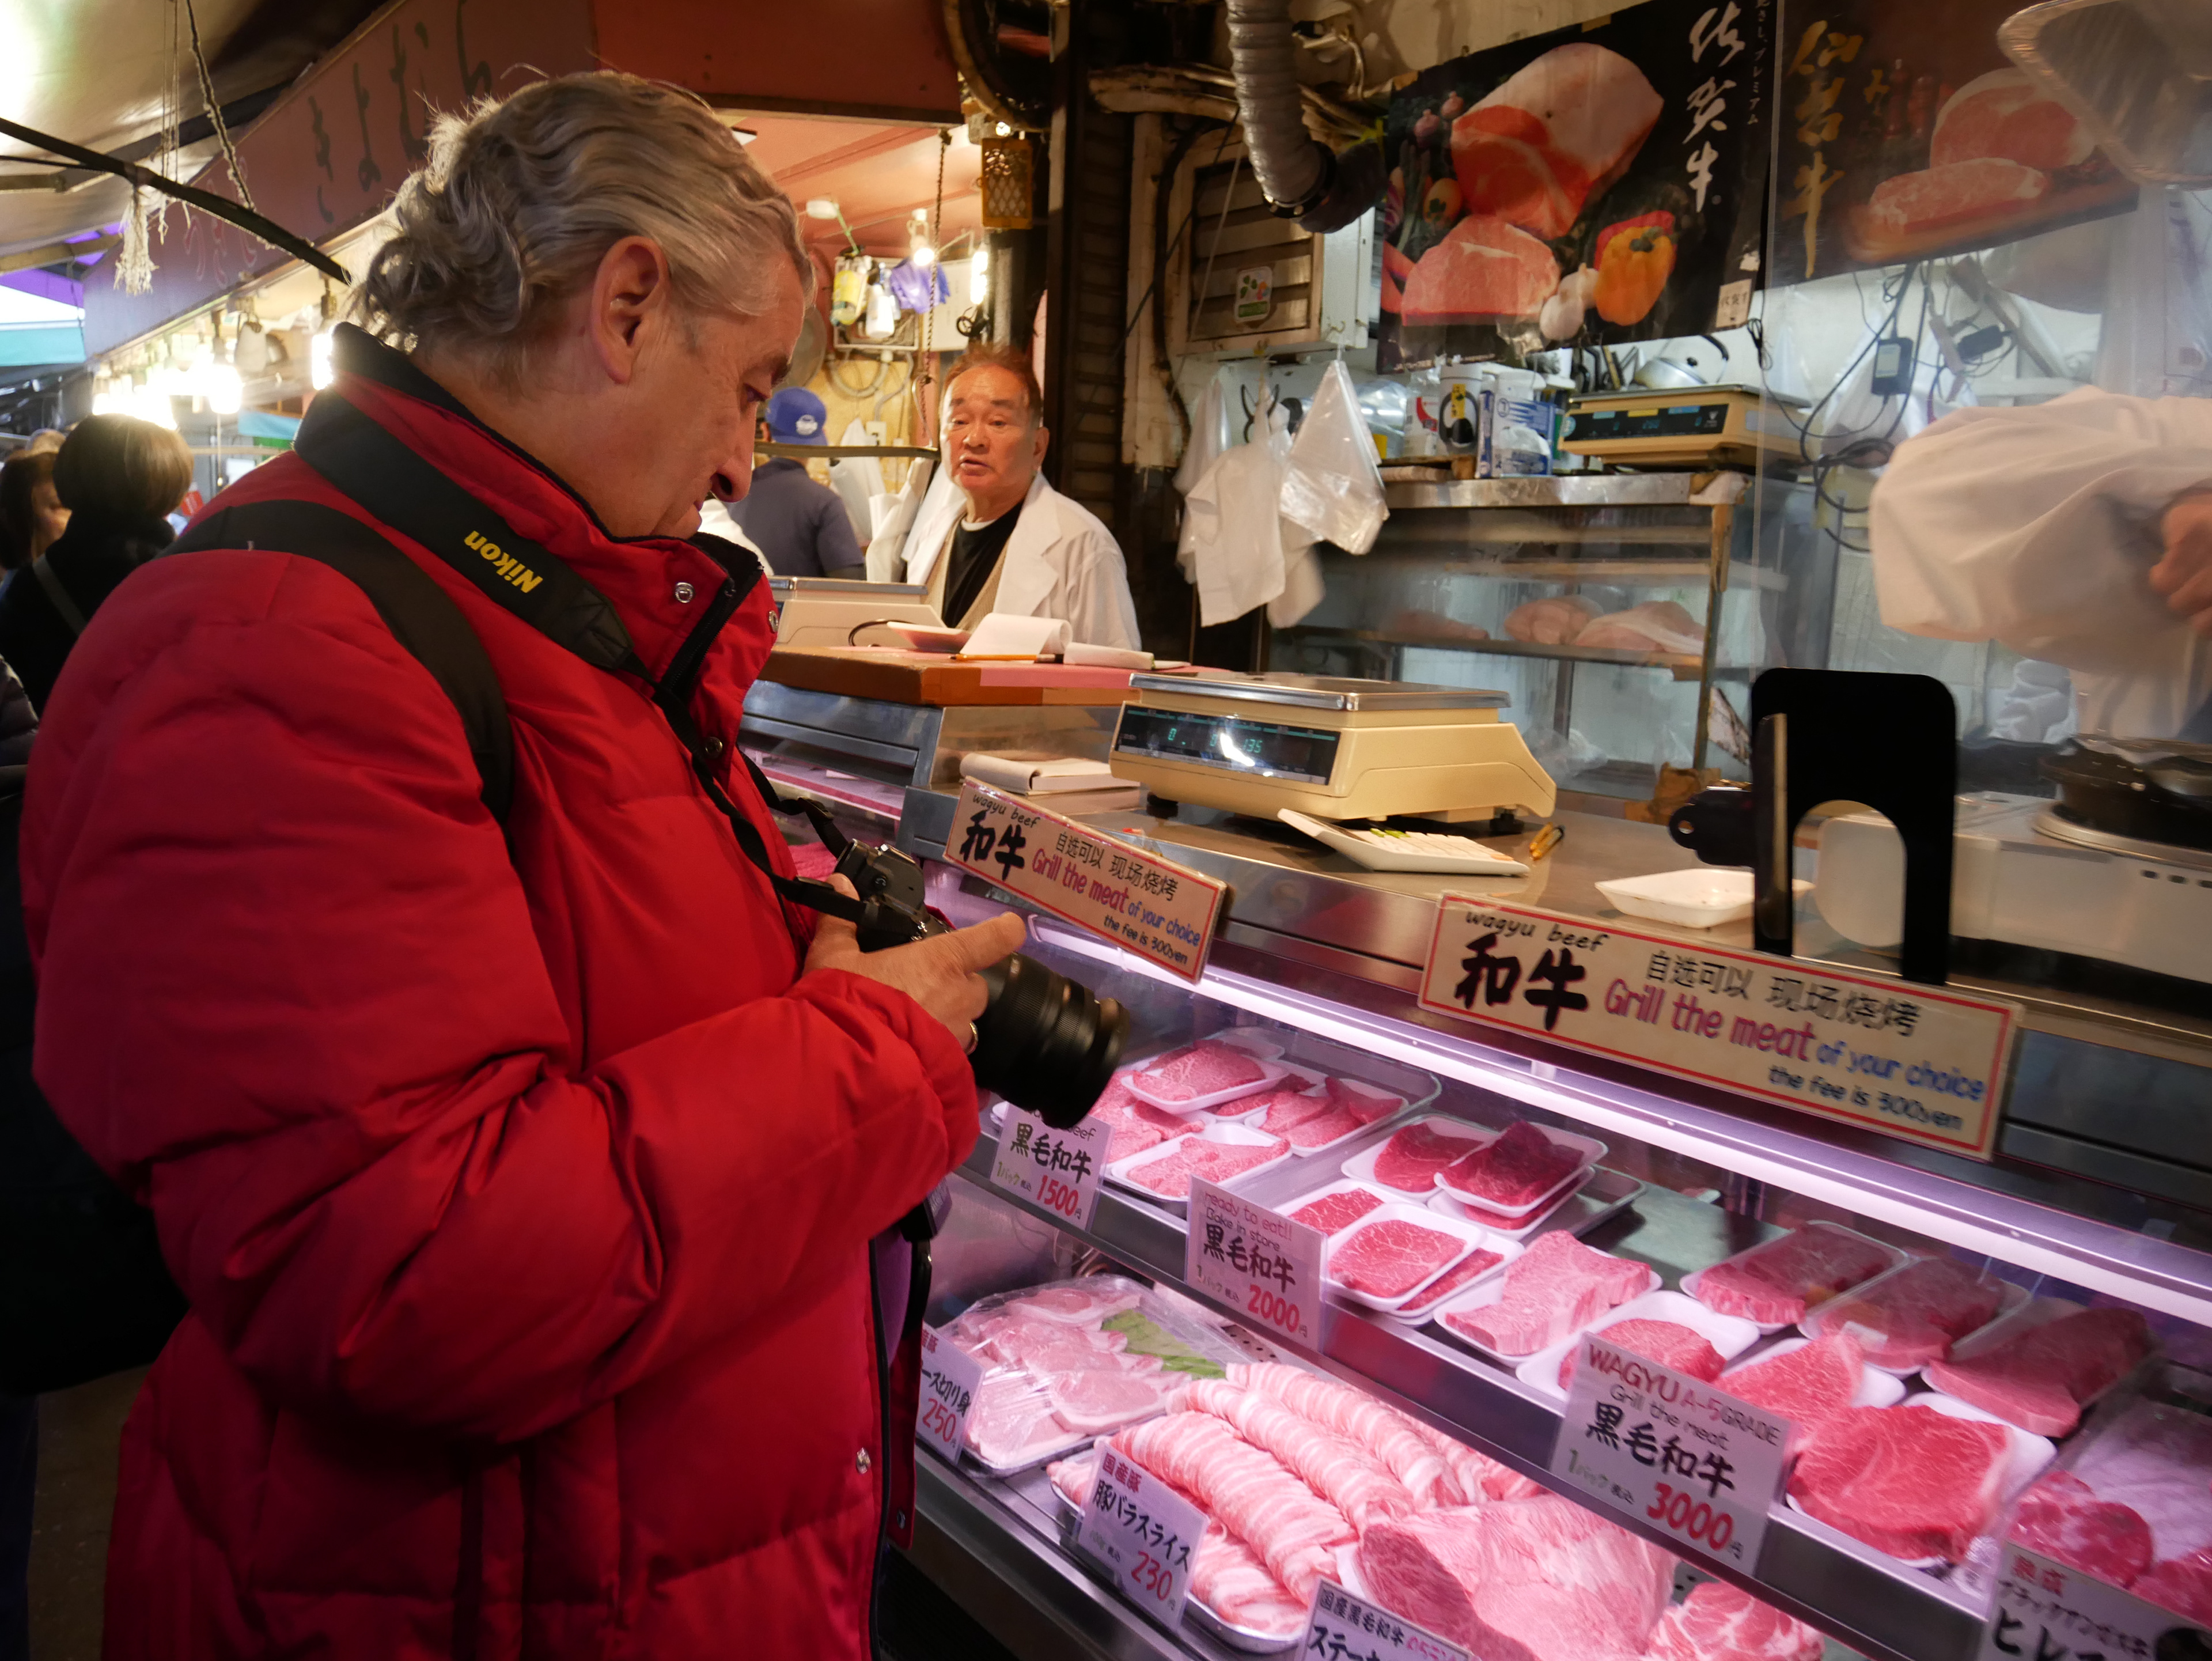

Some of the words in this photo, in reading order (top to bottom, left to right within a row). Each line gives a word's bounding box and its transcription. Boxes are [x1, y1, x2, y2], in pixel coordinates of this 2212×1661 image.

[464, 530, 544, 593] Nikon
[973, 793, 1007, 816] wagyu
[1010, 805, 1040, 828] beef
[959, 811, 1027, 881] 和牛
[1055, 832, 1105, 870] 自选可以
[1108, 855, 1178, 902] 现场烧烤
[1032, 848, 1062, 880] Grill
[1063, 861, 1088, 894] the
[1088, 881, 1129, 914] meat
[1128, 899, 1143, 916] of
[1140, 907, 1165, 929] your
[1166, 918, 1201, 947] choice
[1104, 914, 1120, 933] the
[1122, 924, 1138, 942] fee
[1139, 932, 1148, 946] is
[1151, 936, 1189, 965] 300yen
[1465, 911, 1535, 938] wagyu
[1547, 923, 1611, 952] beef
[1454, 932, 1588, 1031] 和牛
[1645, 949, 1755, 1001] 自选可以
[1764, 975, 1922, 1037] 现场烧烤
[1604, 978, 1666, 1025] Grill
[1671, 992, 1723, 1039] the
[1729, 1015, 1816, 1062] meat
[1816, 1040, 1847, 1065] of
[1846, 1051, 1902, 1080] your
[1904, 1060, 1986, 1102] choice
[1768, 1065, 1804, 1089] the
[1809, 1075, 1847, 1102] fee
[1850, 1085, 1872, 1107] is
[1877, 1092, 1963, 1132] 300yen
[1010, 1122, 1092, 1184] 黒毛和牛
[1205, 1192, 1240, 1217] ready
[1244, 1206, 1258, 1224] to
[1236, 1223, 1247, 1236] in
[1249, 1229, 1281, 1253] store
[1203, 1223, 1296, 1294] 黒毛和牛
[1588, 1342, 1680, 1405] WAGYU
[1585, 1399, 1737, 1499] 黒毛和牛
[1649, 1401, 1680, 1427] the
[1684, 1420, 1730, 1452] meat
[1092, 1479, 1191, 1573] 豚バラスライス
